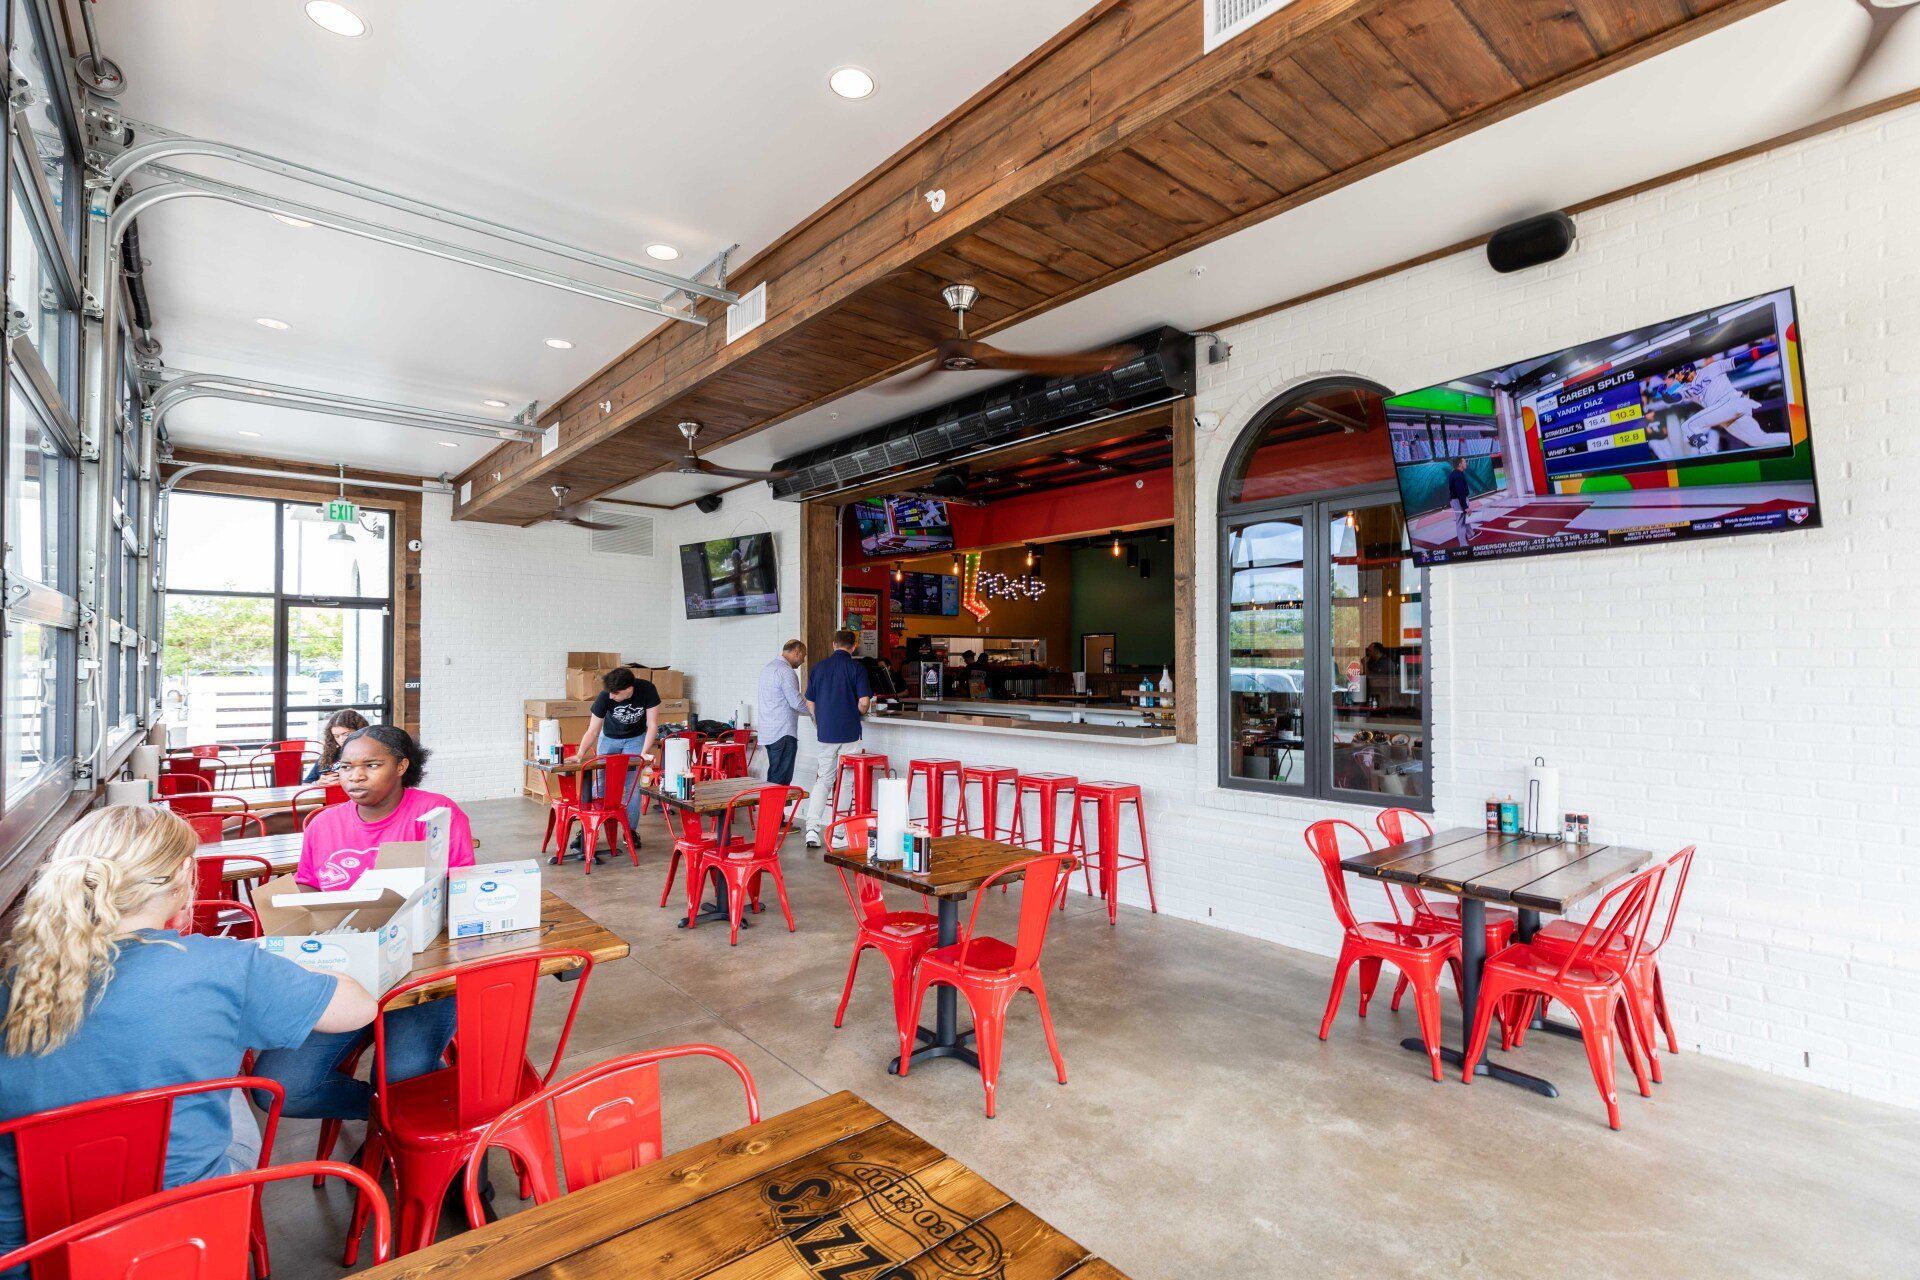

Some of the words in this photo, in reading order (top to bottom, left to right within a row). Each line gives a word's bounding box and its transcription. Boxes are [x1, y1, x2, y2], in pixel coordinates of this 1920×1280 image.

[1559, 385, 1595, 404] CAREER
[1597, 371, 1635, 390] SPLITS
[1544, 425, 1574, 439] STRIKEOUT
[1615, 409, 1636, 420] 10.3
[1556, 404, 1582, 418] YANDY
[1547, 447, 1567, 457] WHIFF
[1619, 432, 1640, 443] 12.8
[329, 503, 355, 522] EXIT
[1473, 543, 1507, 551] ANDERSON
[853, 1167, 924, 1214] SHOP
[911, 1210, 986, 1267] TACO
